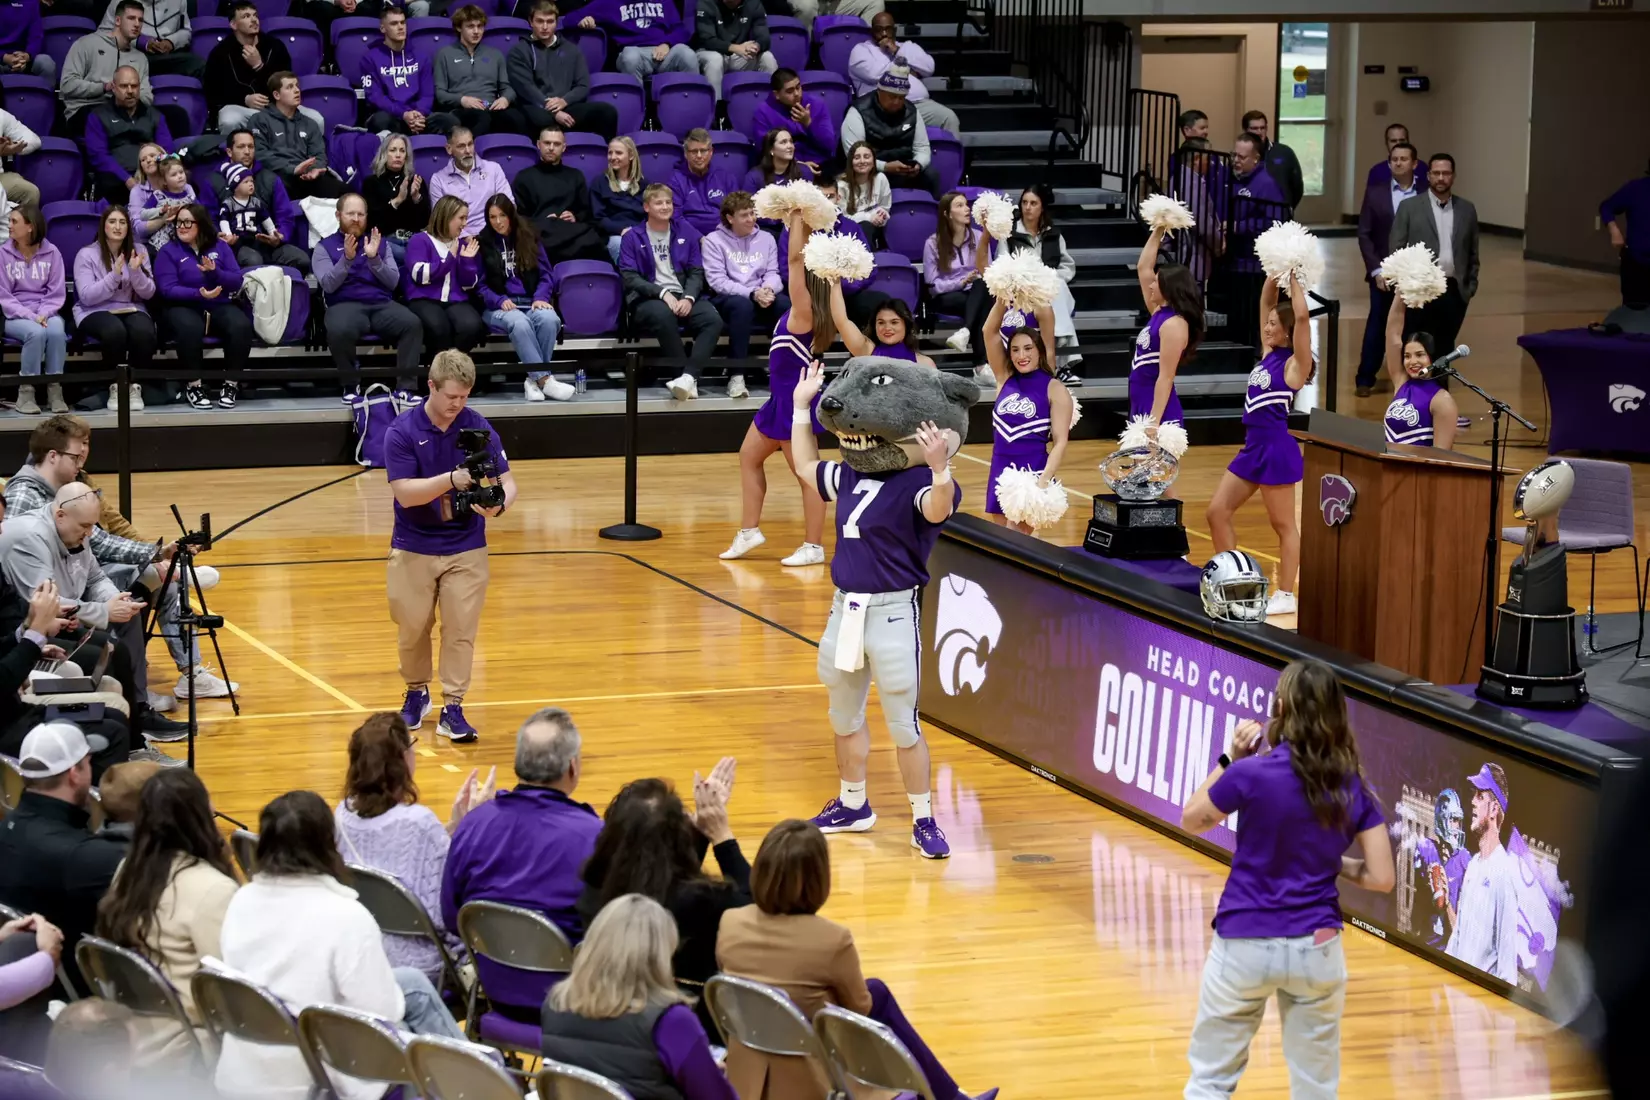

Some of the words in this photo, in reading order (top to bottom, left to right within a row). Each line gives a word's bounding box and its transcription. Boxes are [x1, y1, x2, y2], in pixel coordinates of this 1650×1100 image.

[380, 62, 419, 75] K-STATE
[235, 211, 257, 232] 15
[997, 393, 1036, 419] Cats
[1384, 398, 1419, 427] Cats
[842, 478, 886, 538] 7
[1147, 644, 1200, 688] HEAD
[1092, 662, 1215, 809] COLLIN
[1351, 916, 1386, 939] DAKTRONICS
